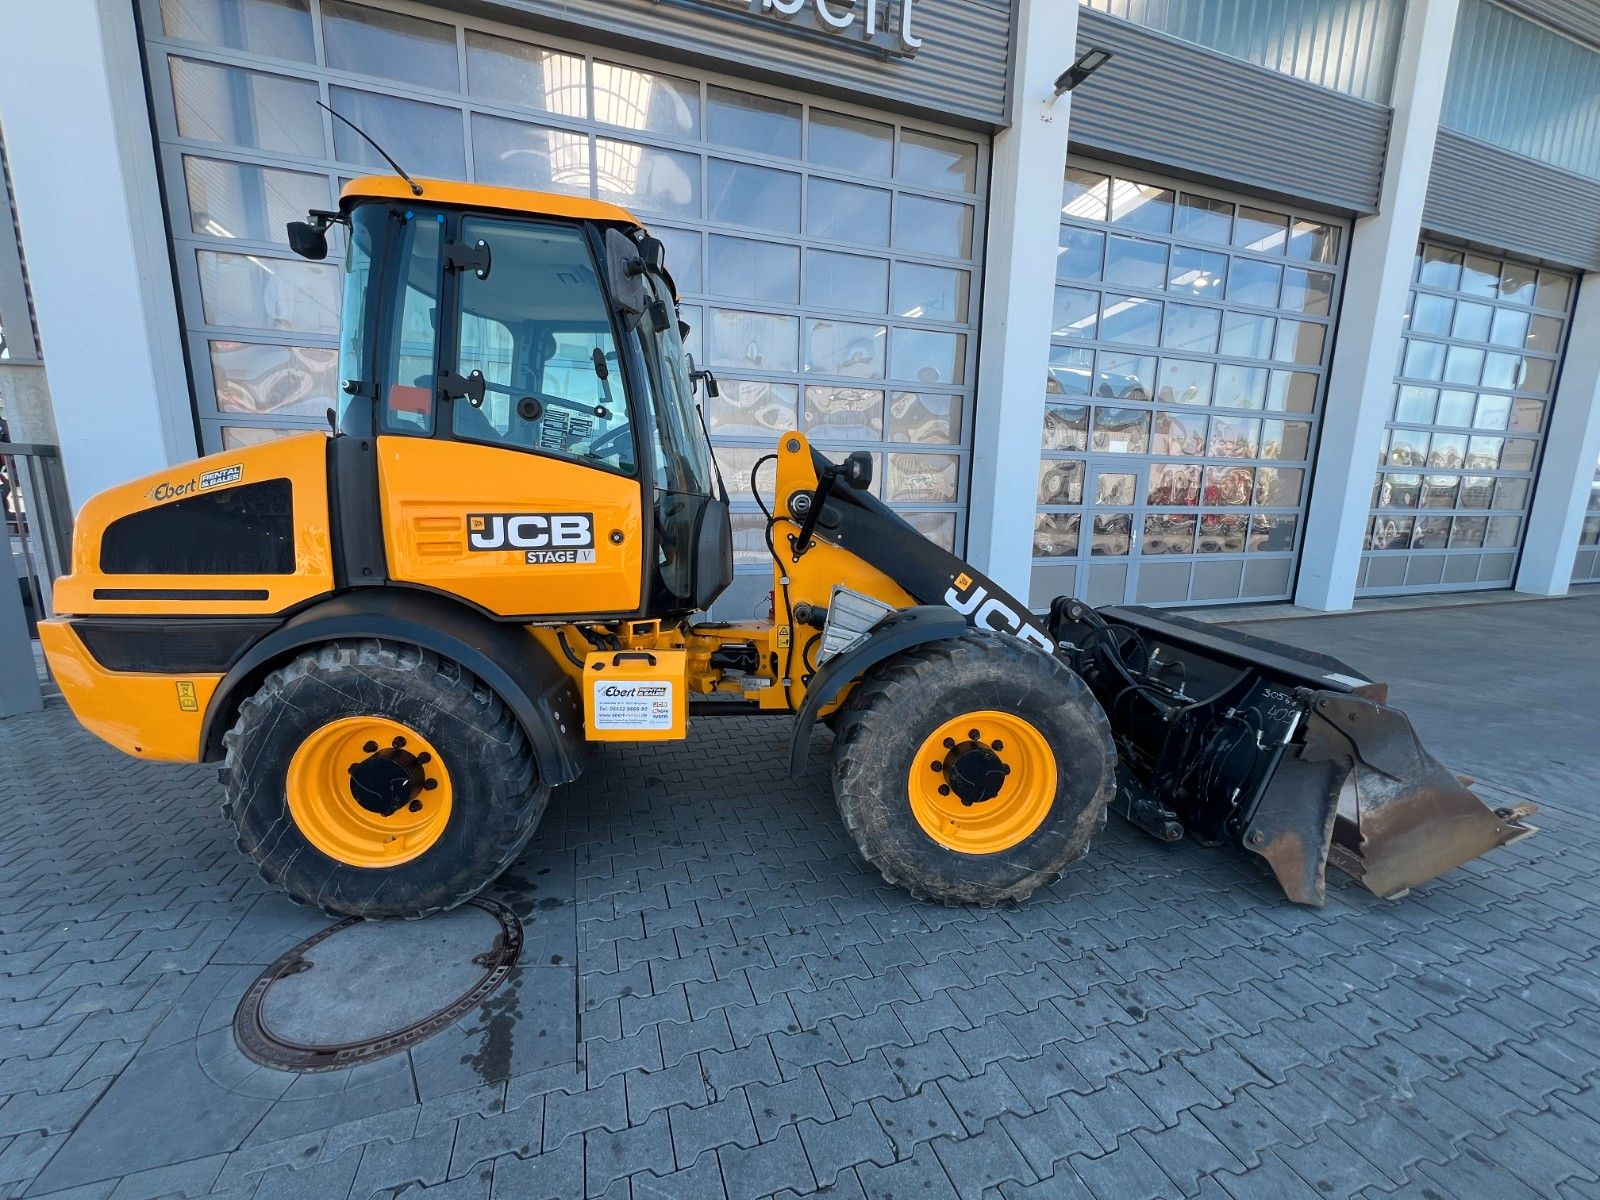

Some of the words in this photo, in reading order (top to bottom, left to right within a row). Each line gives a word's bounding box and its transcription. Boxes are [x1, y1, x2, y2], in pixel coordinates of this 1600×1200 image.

[202, 467, 240, 481] RENTAL
[154, 479, 196, 501] Ebert
[471, 515, 592, 548] JCB
[527, 551, 575, 563] STAGE
[605, 686, 636, 697] Ebert
